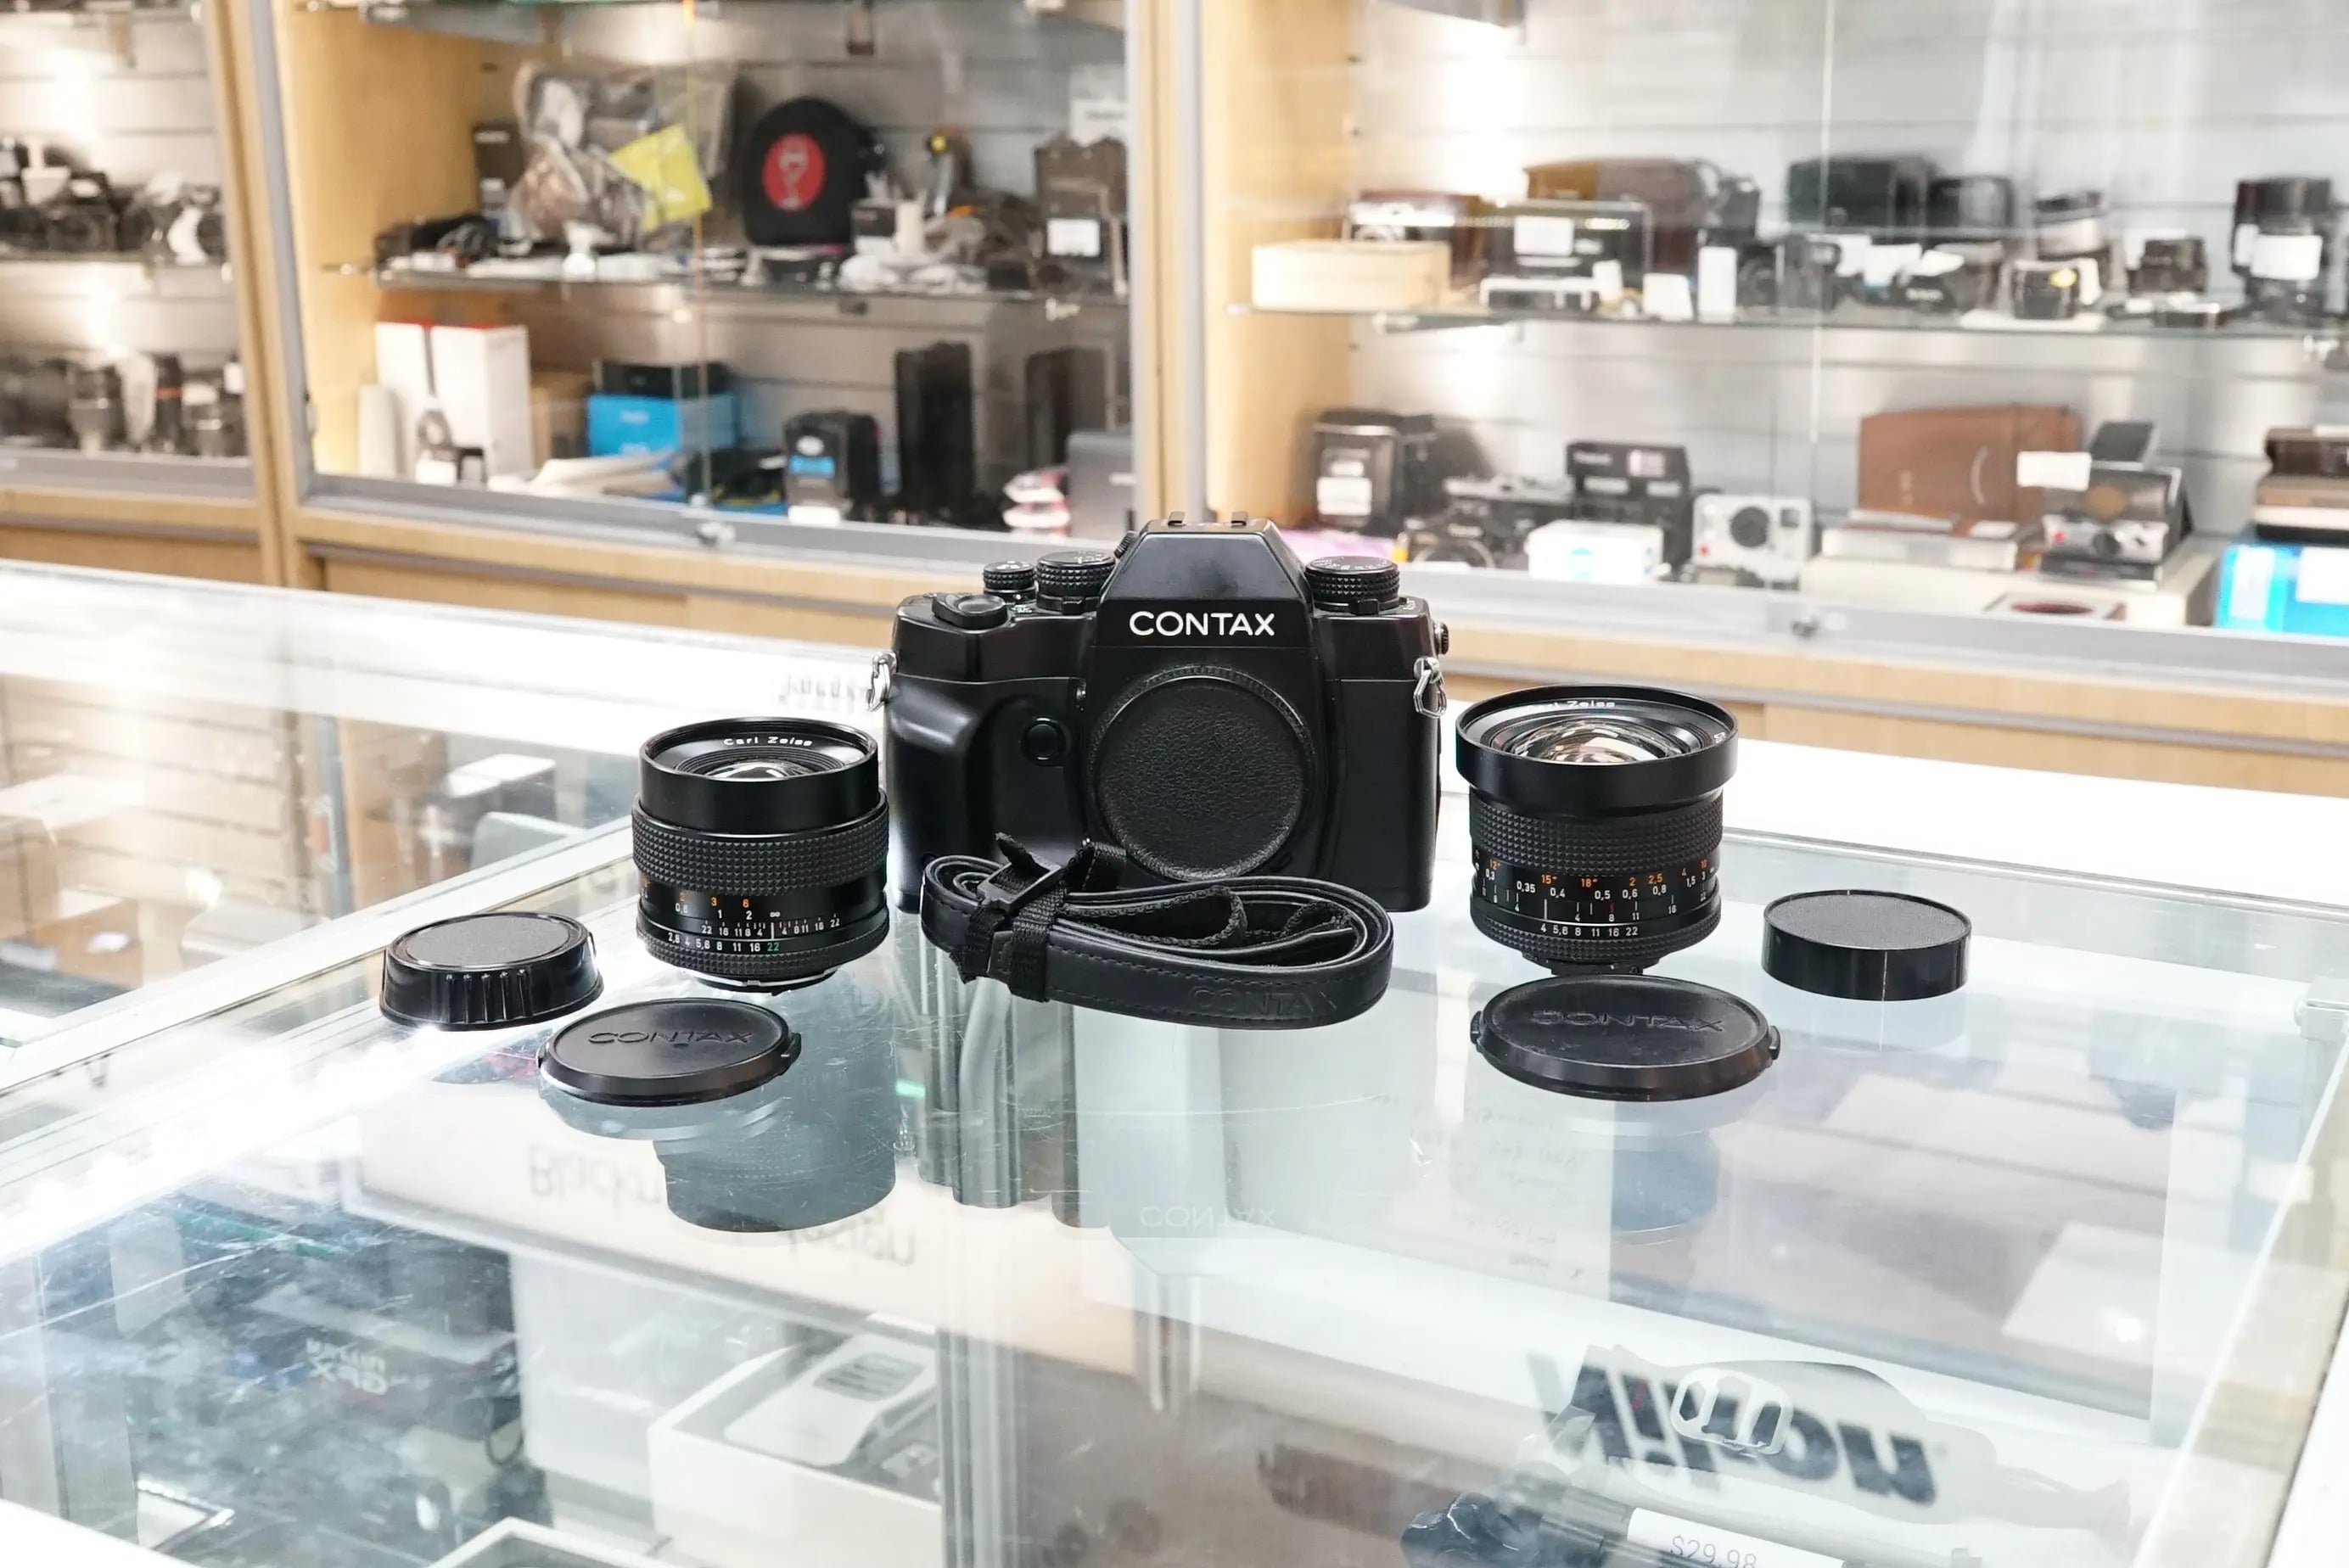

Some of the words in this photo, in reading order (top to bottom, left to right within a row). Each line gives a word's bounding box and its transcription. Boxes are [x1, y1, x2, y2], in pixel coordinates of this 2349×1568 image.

[1129, 611, 1275, 637] CONTAX
[723, 736, 759, 746] Carl
[767, 736, 813, 747] Zeiss
[1629, 877, 1636, 887] 2
[1516, 881, 1535, 893] 0,35
[1550, 887, 1566, 899] 0,4
[1595, 889, 1611, 900] 0,5
[1622, 888, 1639, 899] 0,6
[710, 897, 718, 906] 3
[743, 899, 750, 908] 6
[717, 909, 722, 919] 1
[746, 910, 753, 921] 2
[1574, 913, 1580, 922] 4
[1632, 911, 1640, 921] 11
[701, 925, 713, 935] 22
[734, 928, 743, 937] 11
[757, 928, 763, 937] 4
[782, 927, 788, 935] 4
[801, 924, 809, 933] 11
[830, 918, 840, 928] 22
[1540, 923, 1546, 932] 4
[1574, 927, 1581, 937] 8
[1592, 928, 1600, 937] 11
[1608, 927, 1619, 937] 16
[1626, 927, 1638, 936] 22
[684, 937, 690, 946] 4
[716, 941, 723, 951] 8
[732, 943, 742, 952] 11
[766, 942, 780, 952] 22
[1191, 985, 1338, 1016] CONTAX
[1528, 1010, 1726, 1032] CONTAX
[588, 1032, 754, 1044] CONTAX
